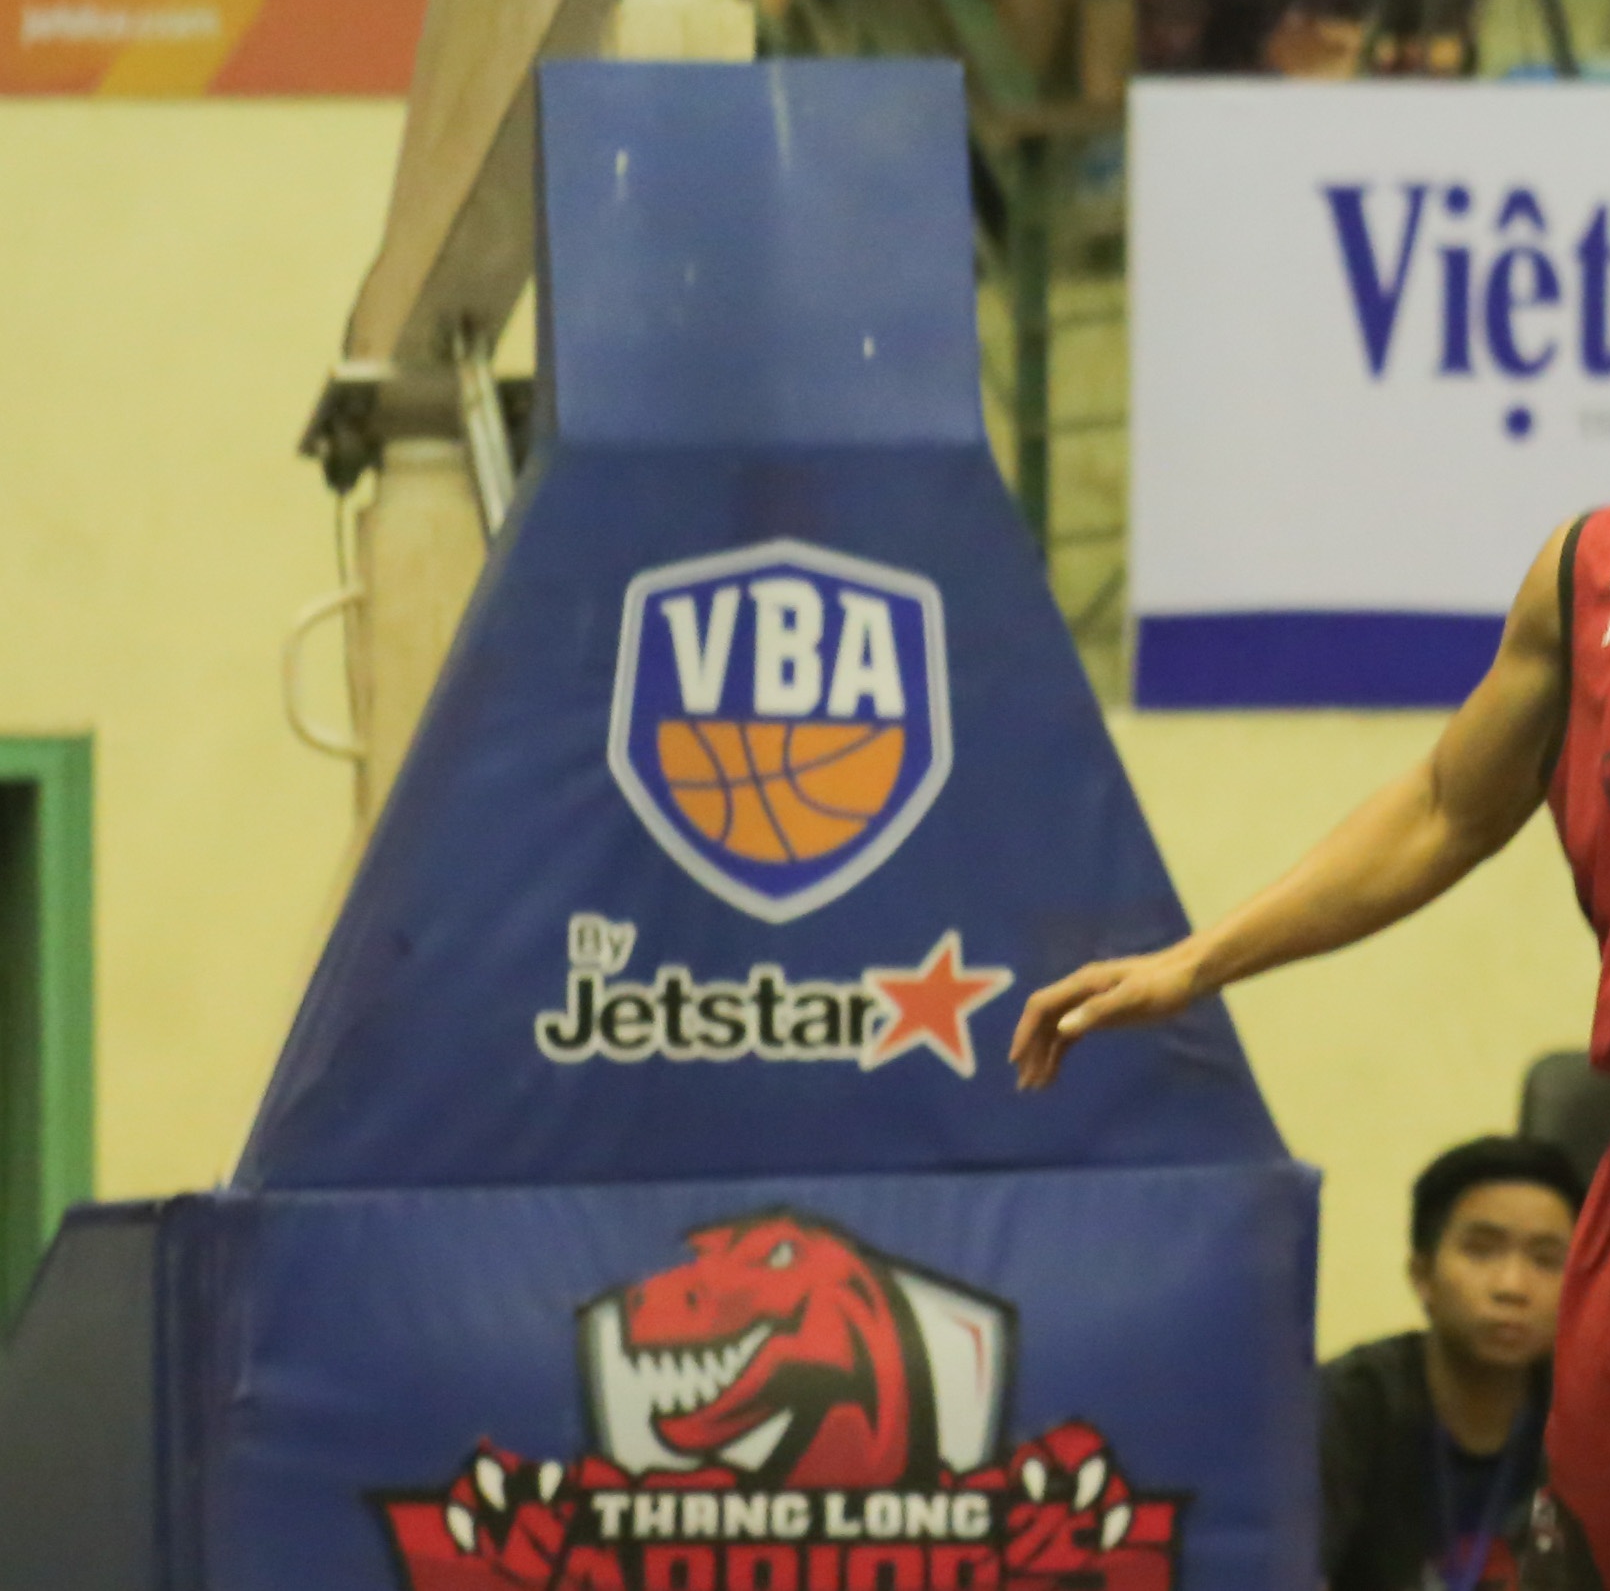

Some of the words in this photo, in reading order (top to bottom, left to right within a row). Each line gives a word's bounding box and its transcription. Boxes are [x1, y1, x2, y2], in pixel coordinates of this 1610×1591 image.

[661, 578, 905, 718] VBA
[577, 918, 633, 970] By
[544, 973, 884, 1053] Jetstar
[592, 1490, 810, 1539] THANG
[822, 1490, 991, 1539] LONG
